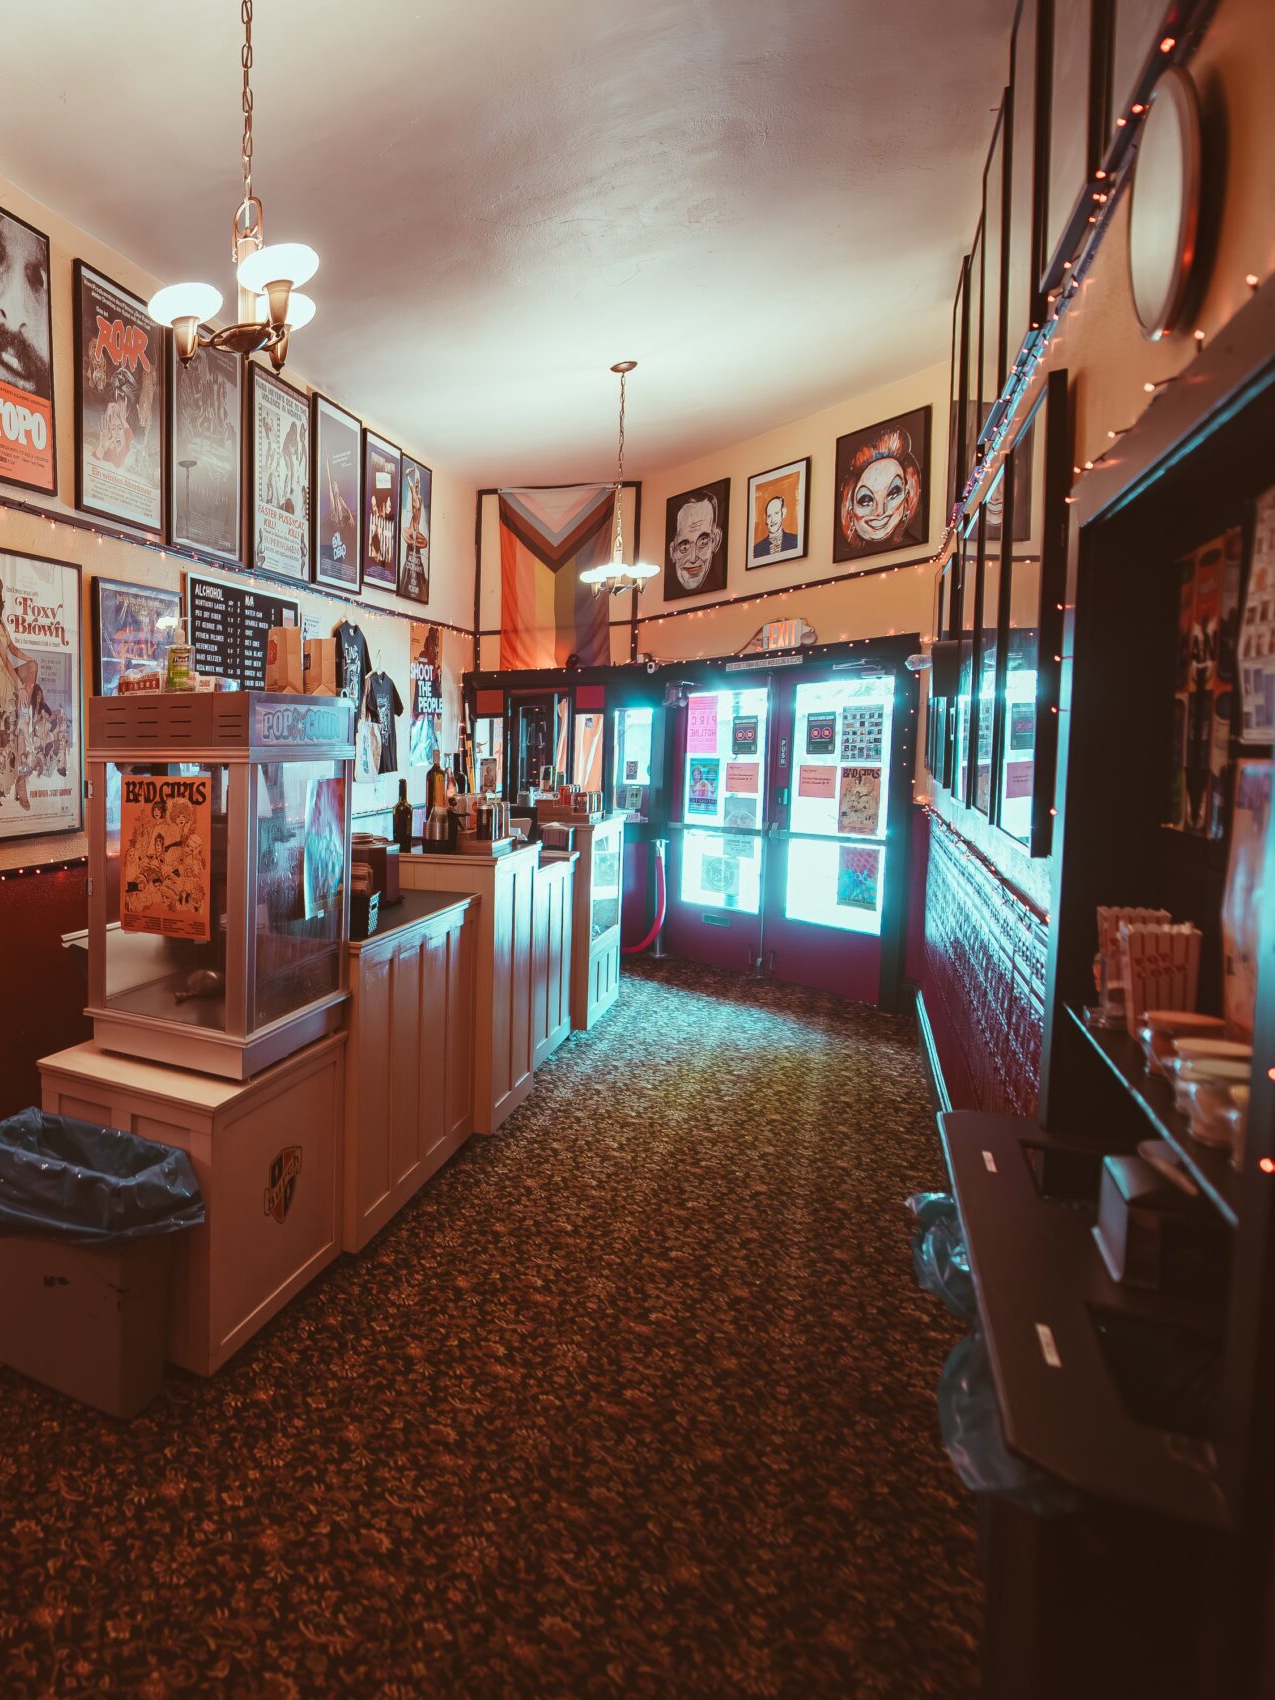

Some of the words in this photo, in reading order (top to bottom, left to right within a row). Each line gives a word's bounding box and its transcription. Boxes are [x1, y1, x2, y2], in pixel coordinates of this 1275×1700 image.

[95, 315, 151, 373] ROAR
[91, 466, 102, 478] Ein
[258, 503, 280, 518] FASTER
[263, 517, 277, 530] KILL!
[287, 527, 301, 540] KILL!
[195, 583, 225, 602] ALCHOHOL
[14, 596, 64, 623] Foxy
[7, 613, 70, 647] Brown
[768, 620, 798, 648] EXIT
[410, 662, 434, 682] SHOOT
[417, 681, 432, 697] THE
[418, 696, 443, 713] PEOPLE
[262, 708, 294, 741] POP
[305, 708, 342, 742] CORN
[842, 768, 858, 778] BAD
[858, 768, 880, 779] GIRLS
[125, 780, 157, 804] BAD
[158, 780, 207, 805] GIRLS
